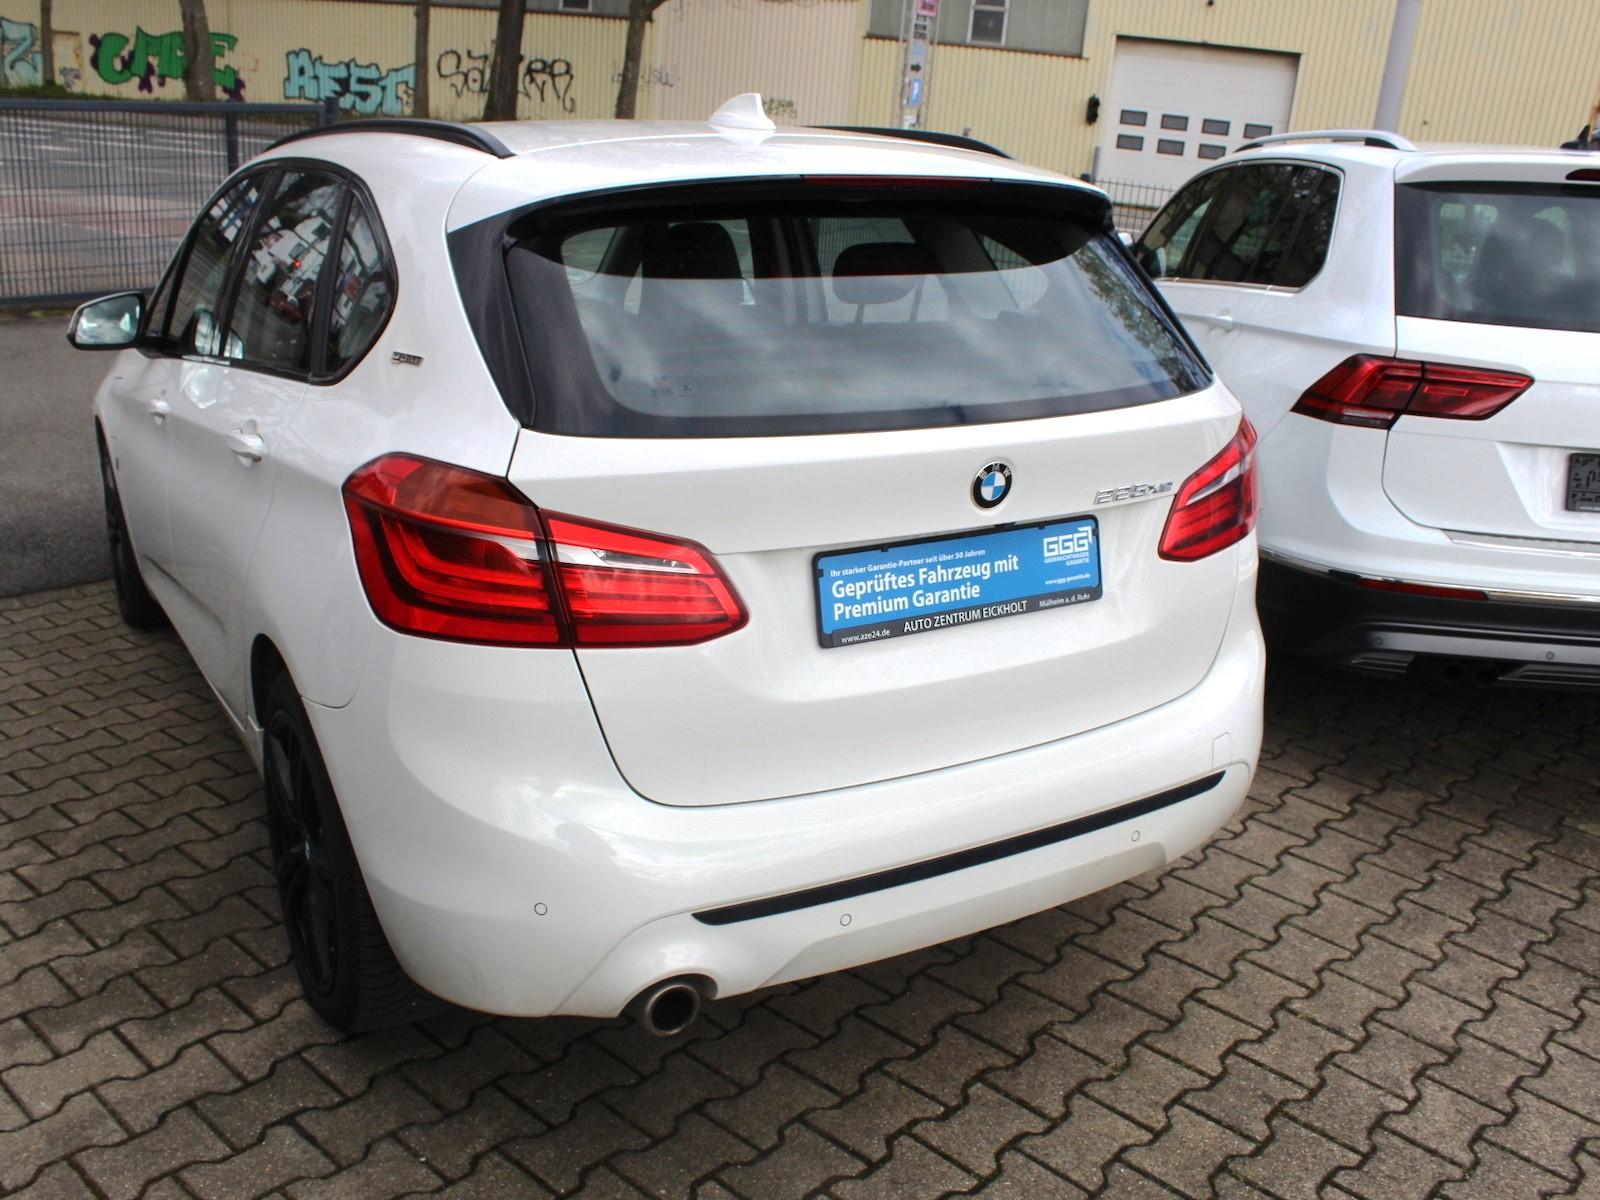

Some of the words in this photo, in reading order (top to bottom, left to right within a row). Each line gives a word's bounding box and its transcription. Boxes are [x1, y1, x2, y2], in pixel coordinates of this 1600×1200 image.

[1043, 531, 1089, 557] GGG
[830, 569, 841, 577] Ihr
[842, 566, 867, 576] starker
[867, 557, 925, 572] Garantie-Partner
[925, 555, 938, 564] seit
[939, 553, 954, 562] über
[955, 551, 963, 559] 50
[964, 549, 986, 558] Jahren
[832, 572, 915, 600] Geprüftes
[918, 561, 991, 585] Fahrzeug
[994, 554, 1019, 573] mit
[833, 596, 909, 621] Premium
[912, 582, 980, 607] Garantie
[903, 618, 932, 632] AUTO
[933, 609, 981, 627] ZENTRUM
[983, 600, 1028, 618] EICKHOLT
[841, 628, 891, 643] www.aze24.de
